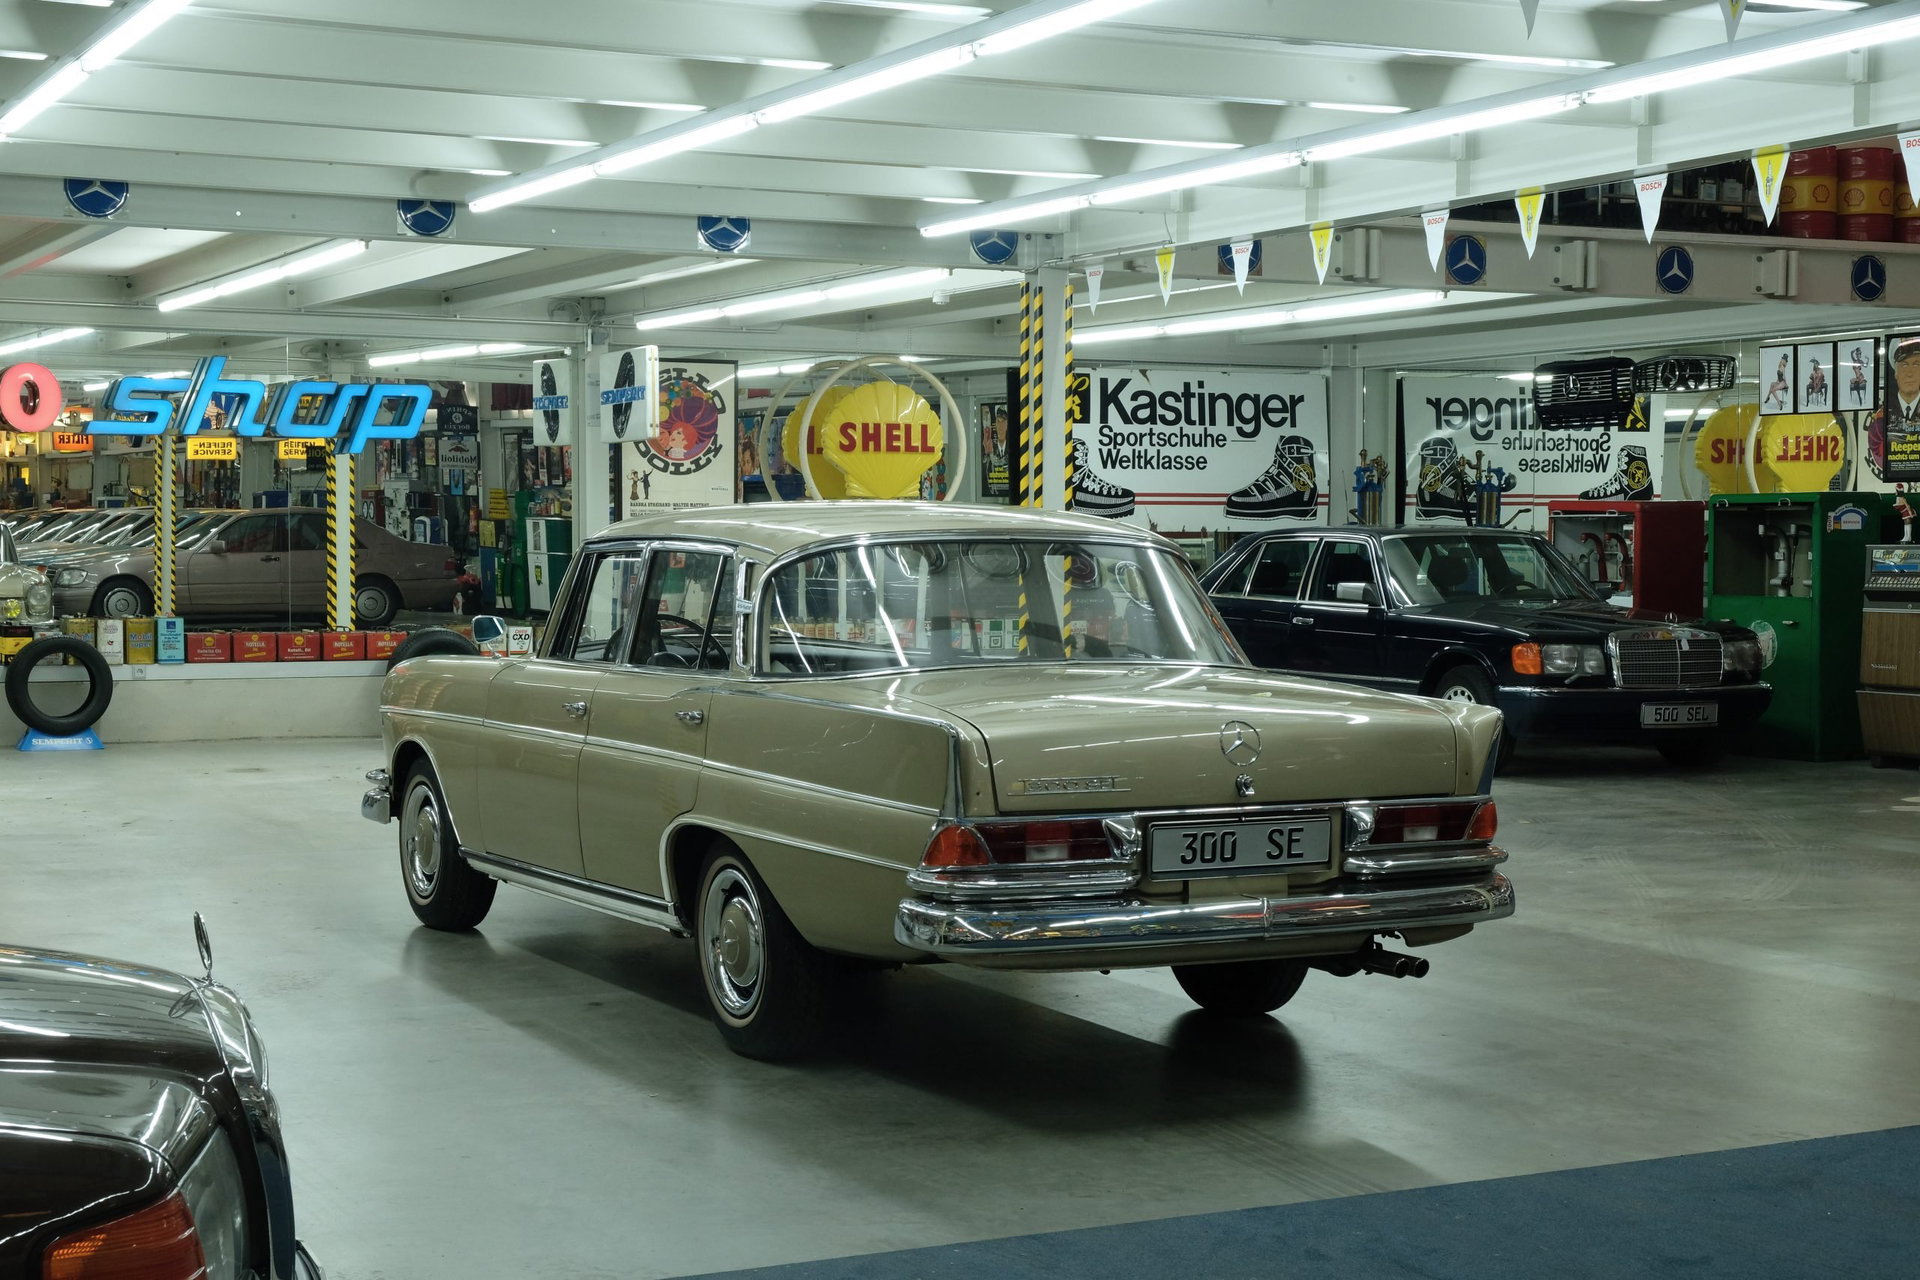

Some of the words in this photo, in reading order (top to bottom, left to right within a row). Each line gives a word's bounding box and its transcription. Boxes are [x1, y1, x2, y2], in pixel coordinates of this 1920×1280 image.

[1640, 181, 1662, 192] BOSCH
[1427, 216, 1445, 226] BOSCH
[1234, 246, 1250, 255] BOSCH
[659, 368, 726, 414] ELLO
[1099, 378, 1305, 438] Kastinger
[838, 422, 935, 453] SHELL
[1098, 425, 1227, 449] Sportschuhe
[634, 433, 723, 475] DOLLY
[1098, 448, 1208, 471] Weltklasse
[130, 633, 152, 641] Mobil
[512, 633, 530, 641] CXD
[1654, 707, 1678, 722] 500
[1687, 706, 1709, 722] SEL
[32, 737, 83, 745] SEMPERIT
[1180, 831, 1237, 865] 300
[1266, 827, 1305, 860] SE
